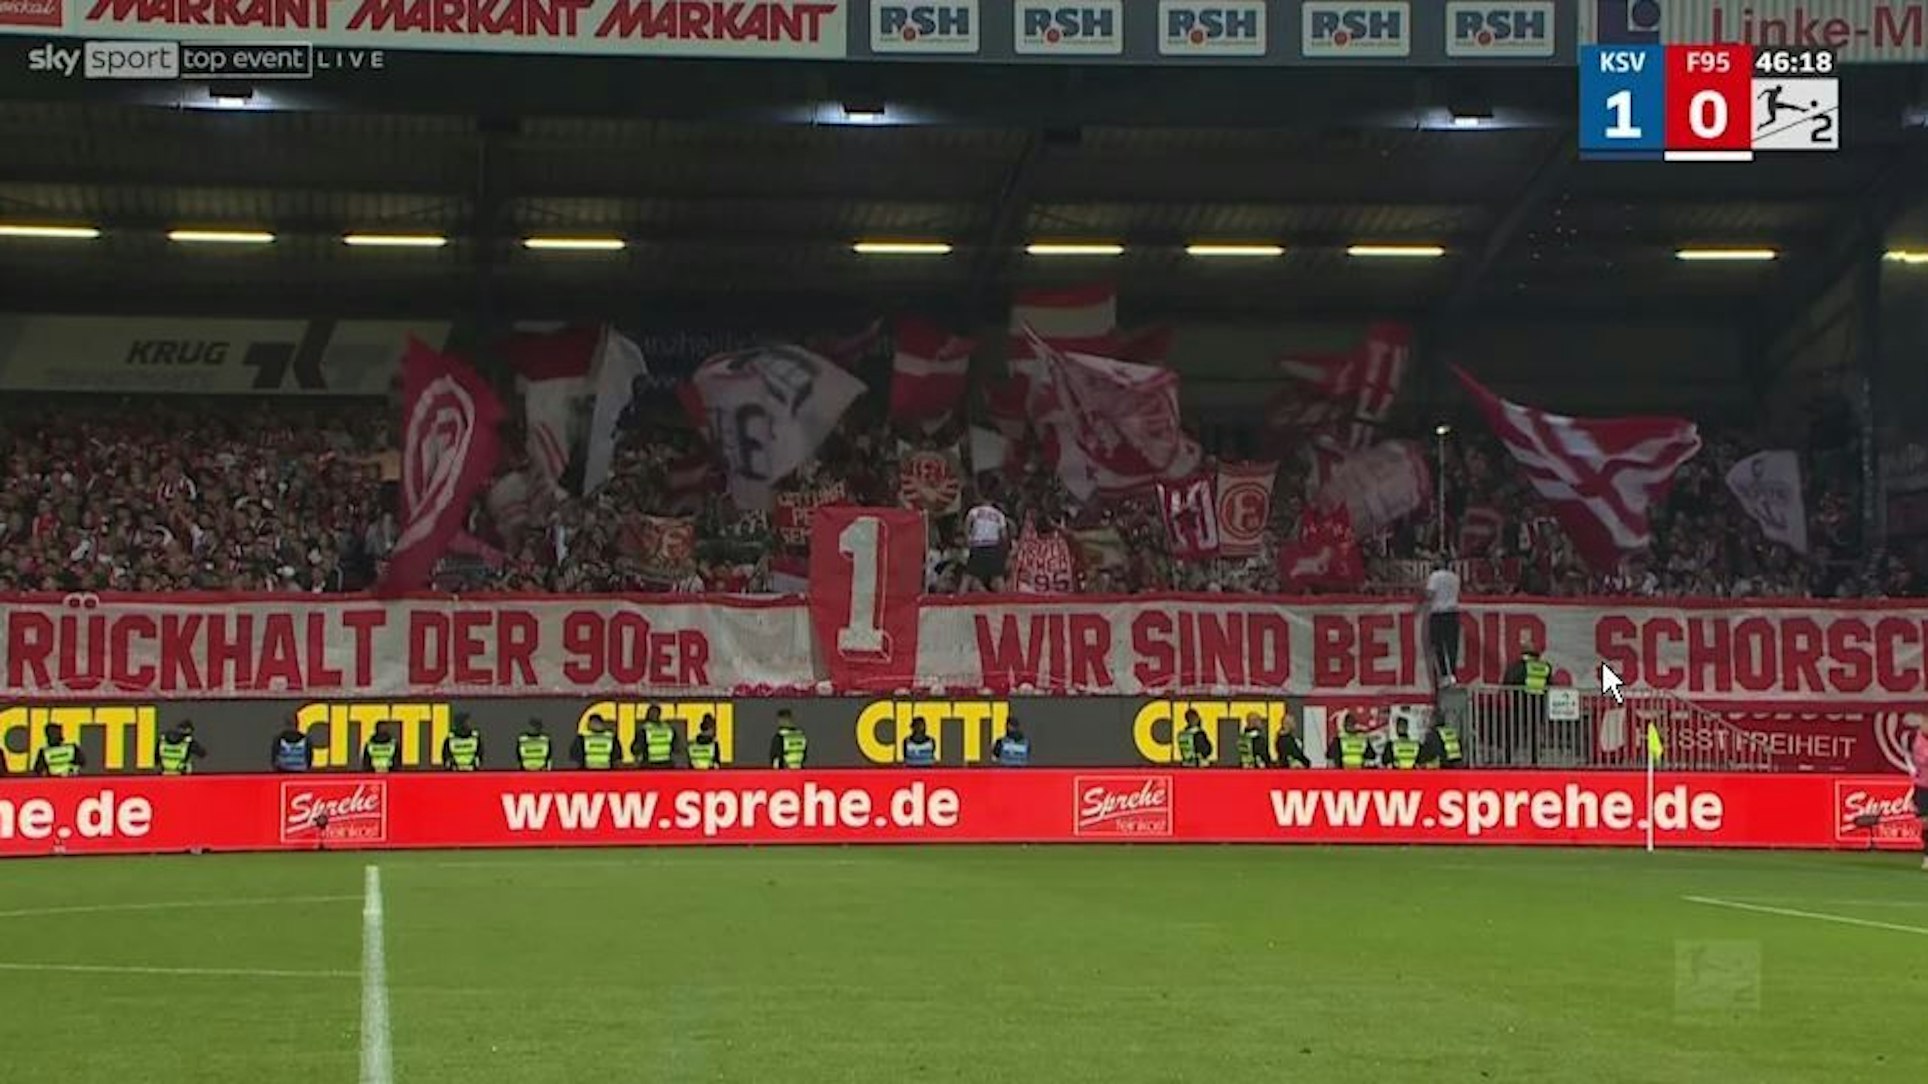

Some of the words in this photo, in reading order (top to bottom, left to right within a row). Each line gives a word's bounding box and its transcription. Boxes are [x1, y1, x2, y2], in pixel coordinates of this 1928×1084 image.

[85, 0, 332, 29] MARKANT
[346, 0, 593, 37] MARKANT
[595, 3, 837, 42] MARKANT
[881, 7, 969, 35] RSH
[1024, 9, 1112, 36] RSH
[1168, 9, 1258, 38] RSH
[1311, 11, 1400, 39] RSH
[1455, 11, 1545, 39] RSH
[125, 340, 231, 366] KRUG
[837, 516, 894, 663] 1
[7, 593, 387, 692] RÜCKHALT
[408, 610, 539, 687] DER
[563, 610, 710, 687] 90ER
[974, 613, 1113, 690] WIR
[1131, 610, 1291, 688] SIND
[1313, 611, 1418, 688] BEI
[1594, 614, 1928, 693] SCHORSC
[501, 782, 960, 836] www.sprehe.de
[1081, 779, 1166, 819] Sprehe
[1270, 783, 1724, 836] www.sprehe.de
[1842, 785, 1916, 822] Spreh
